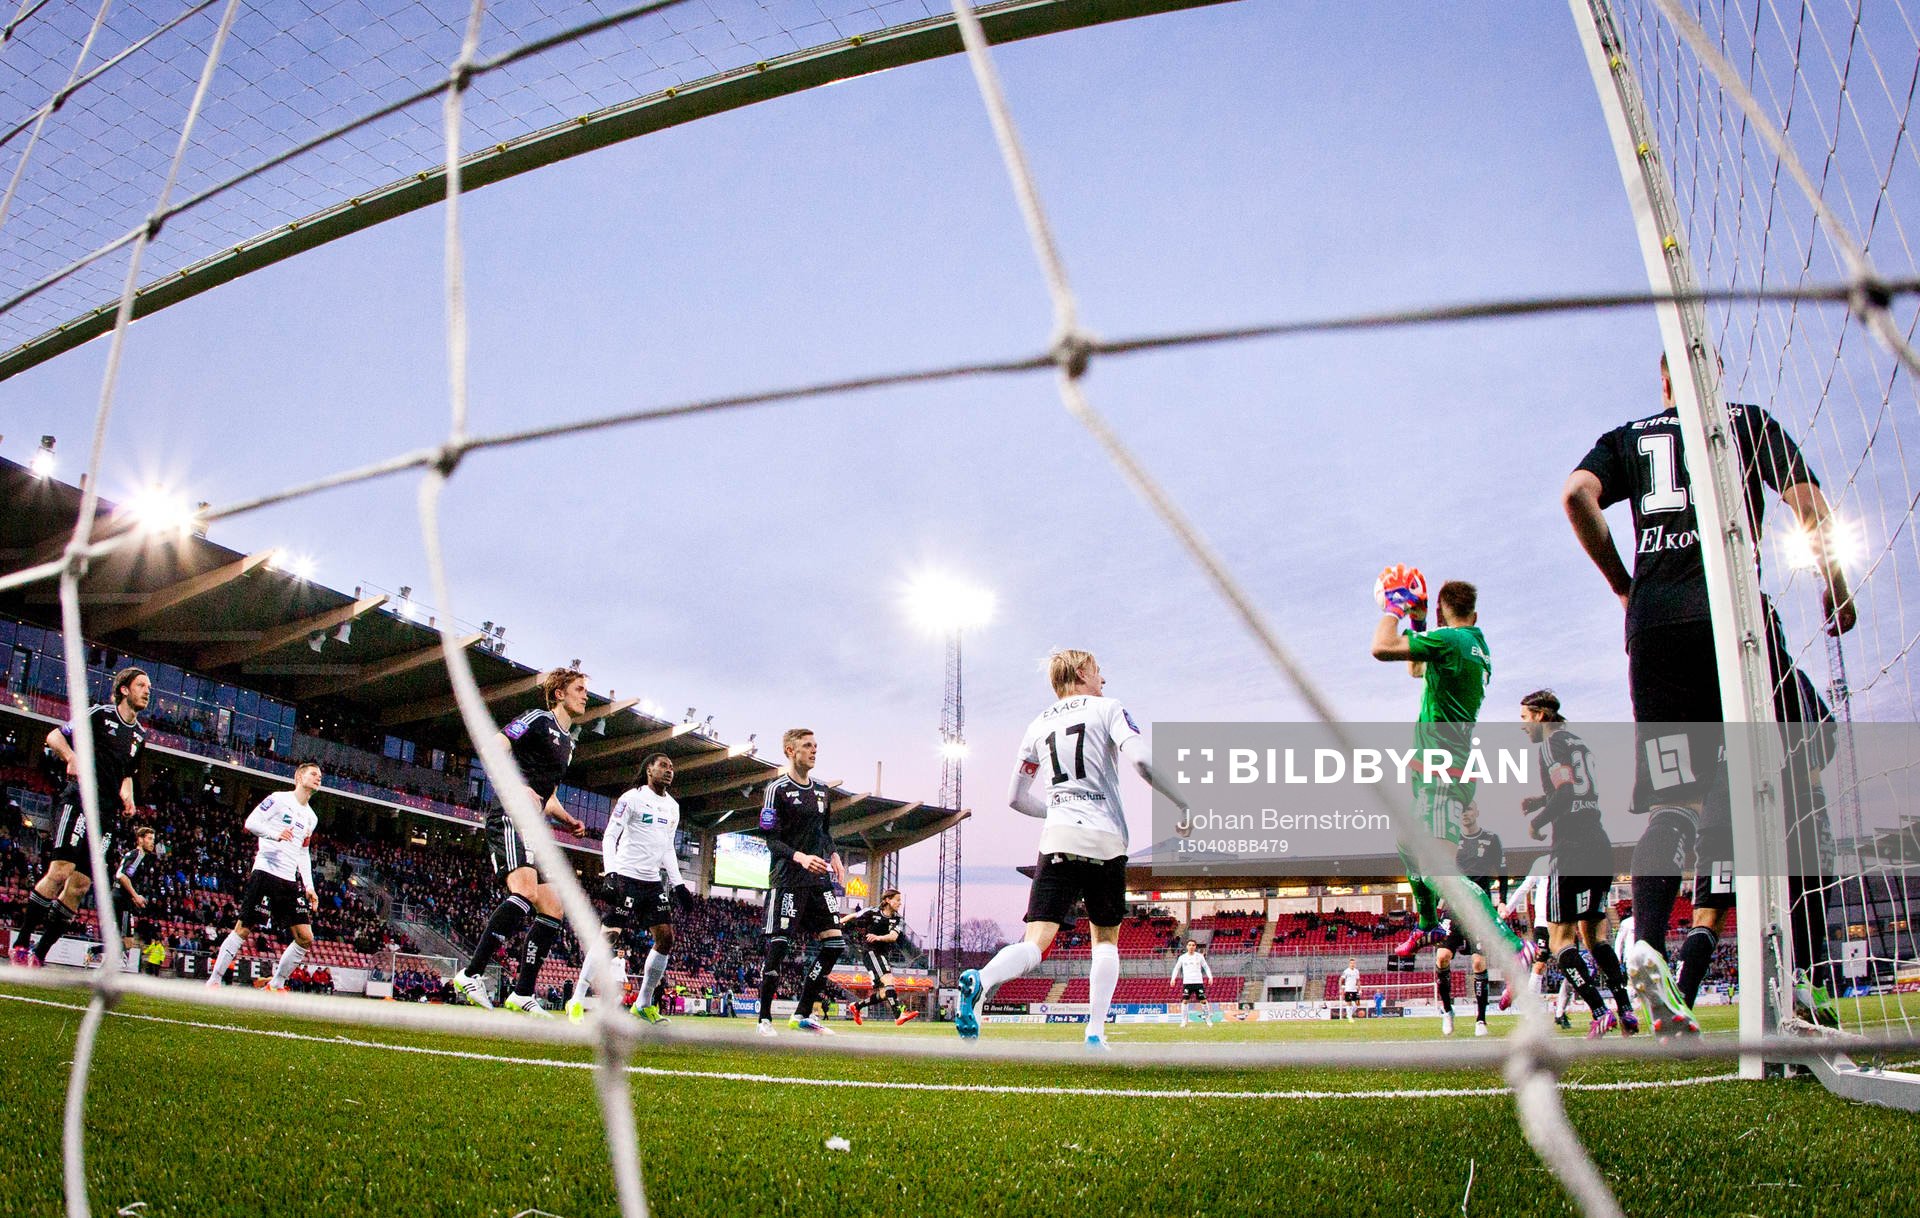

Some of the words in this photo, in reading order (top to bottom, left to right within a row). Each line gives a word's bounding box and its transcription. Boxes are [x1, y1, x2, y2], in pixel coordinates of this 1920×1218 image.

[1637, 433, 1694, 515] 1
[1045, 722, 1087, 786] 17
[1107, 1007, 1127, 1015] PMG
[1138, 1007, 1161, 1015] KPMG
[1267, 1008, 1322, 1019] SWEROCK
